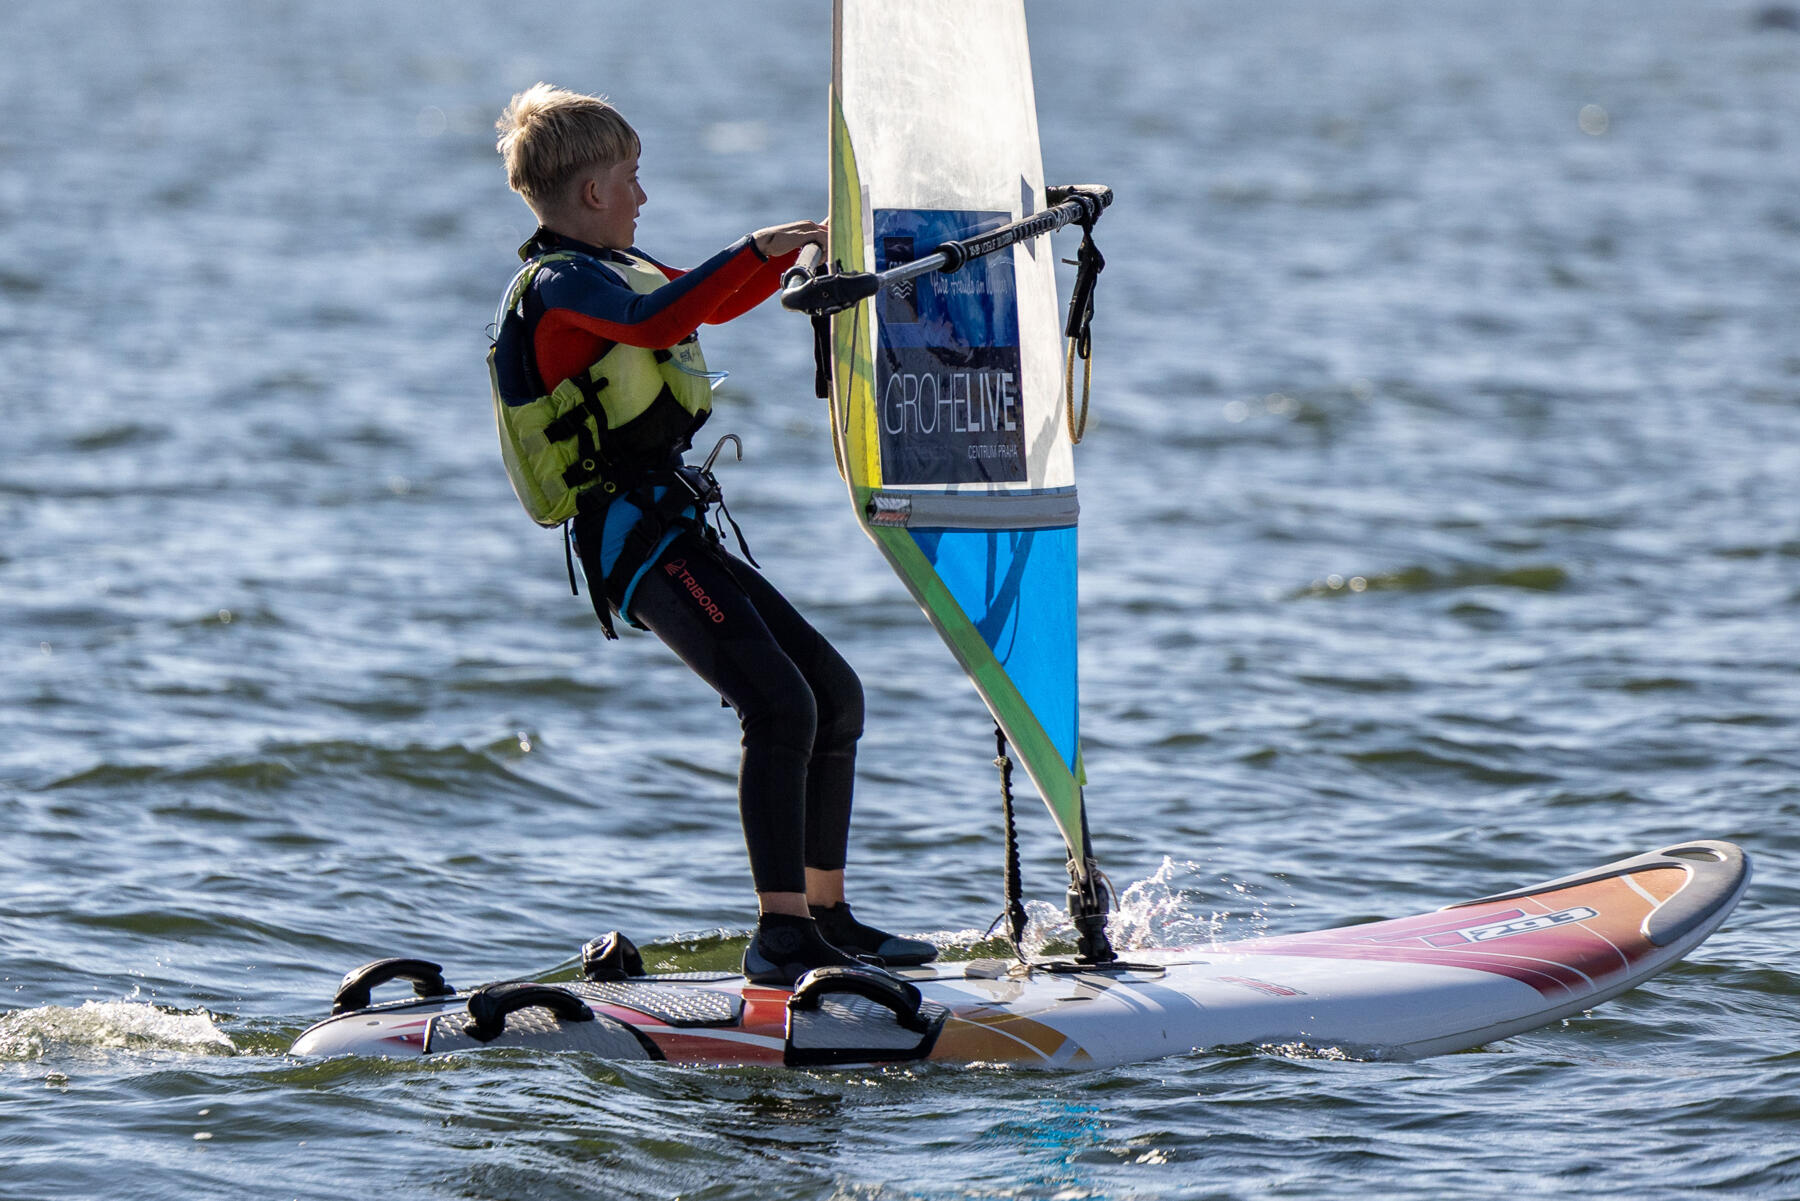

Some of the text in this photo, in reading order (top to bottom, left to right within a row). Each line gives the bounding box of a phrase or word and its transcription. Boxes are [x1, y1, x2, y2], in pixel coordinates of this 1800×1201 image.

[967, 445, 1018, 459] CENTRUM PRAHA
[679, 568, 725, 623] TRIBORD
